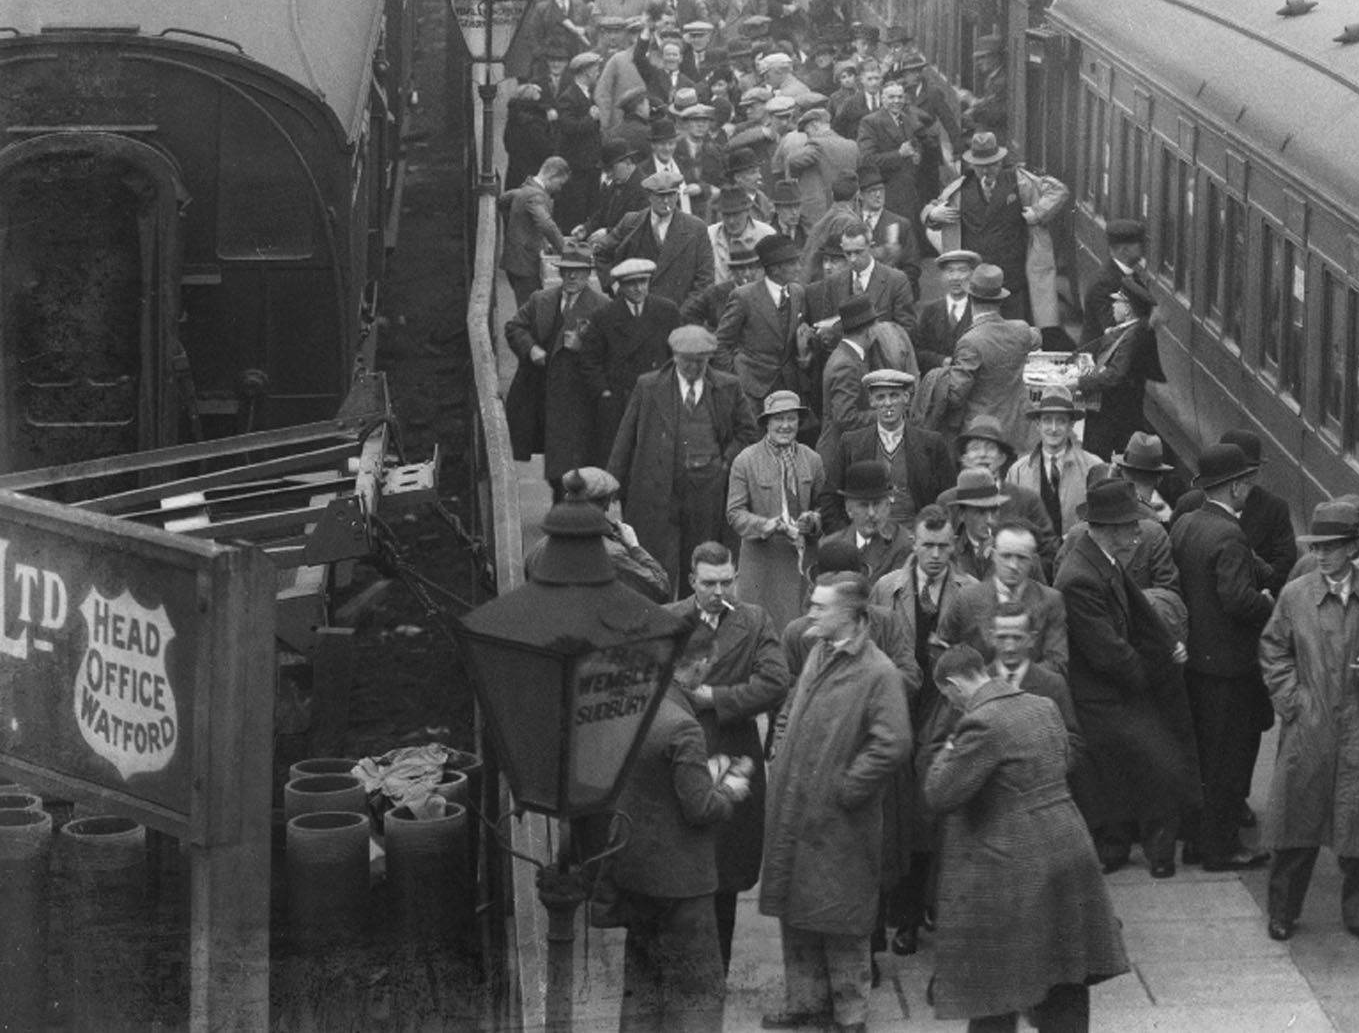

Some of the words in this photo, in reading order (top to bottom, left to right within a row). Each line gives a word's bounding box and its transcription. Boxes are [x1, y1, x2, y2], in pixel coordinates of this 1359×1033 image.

[93, 599, 160, 657] HEAD
[86, 648, 165, 712] OFFICE
[577, 694, 649, 725] SUDBURY
[80, 685, 175, 755] WATFORD
